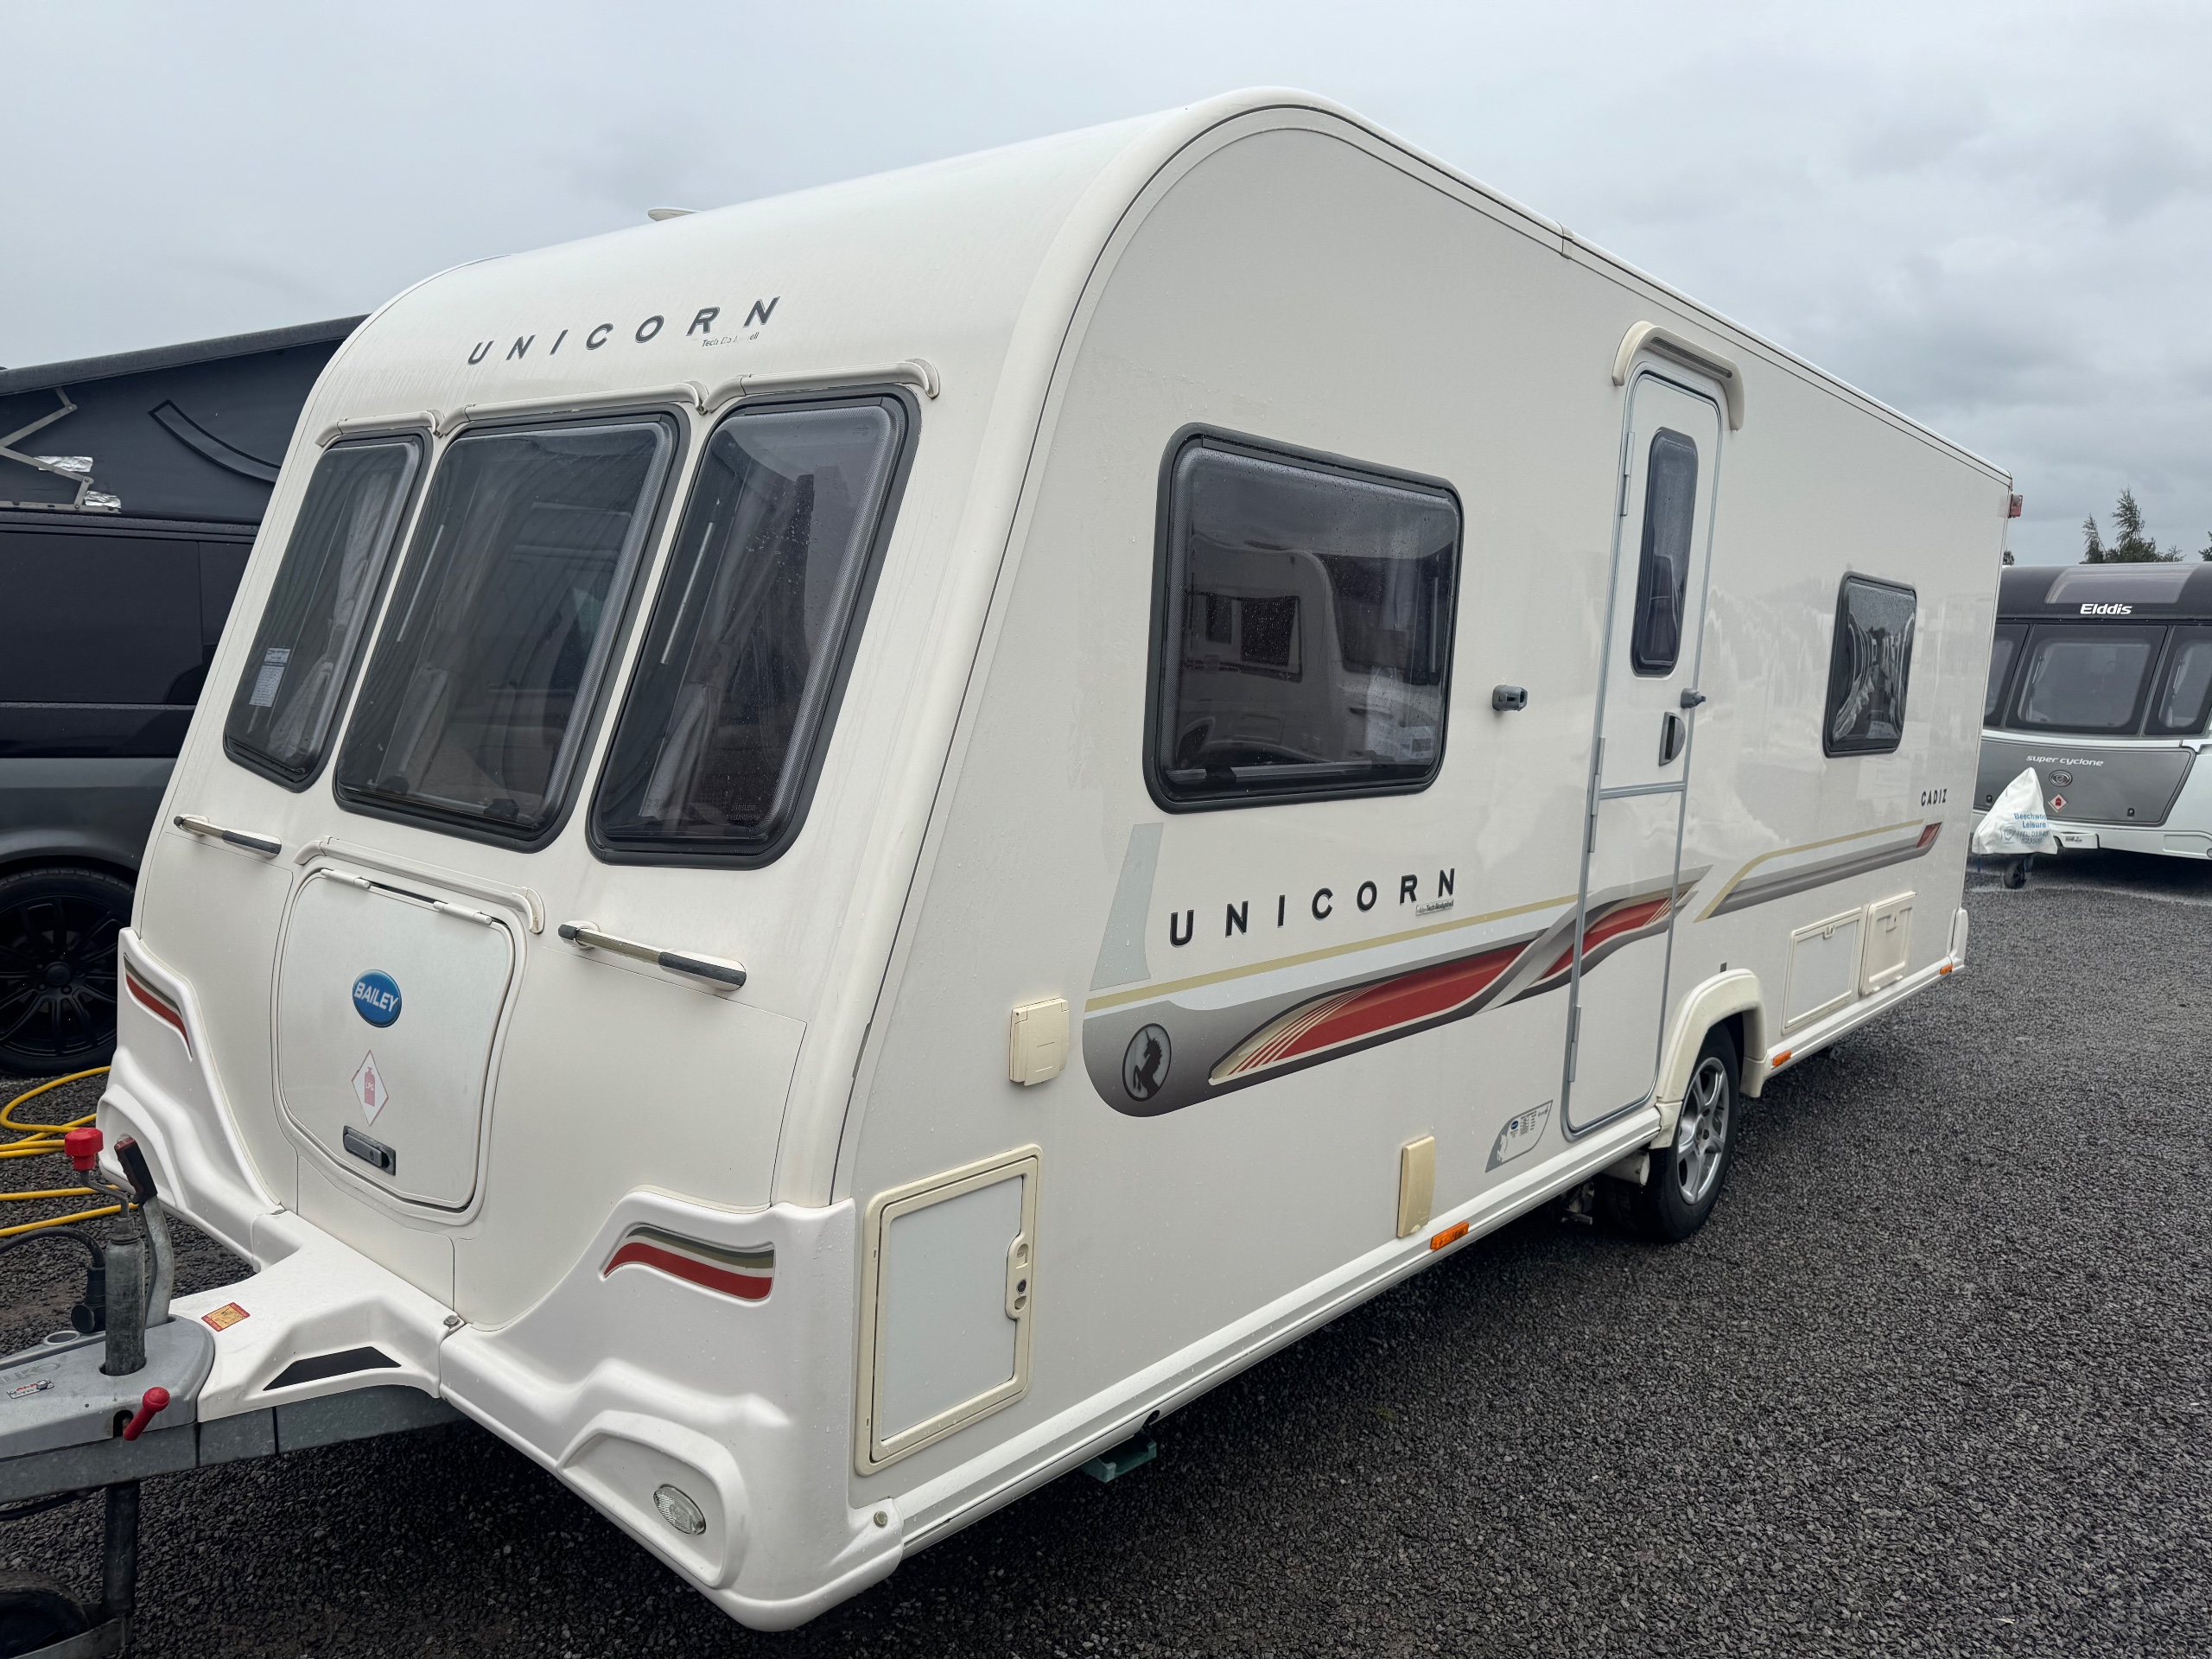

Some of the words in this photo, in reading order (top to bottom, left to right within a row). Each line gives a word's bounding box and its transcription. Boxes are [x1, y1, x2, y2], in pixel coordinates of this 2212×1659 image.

[467, 296, 781, 366] UNICORN
[2080, 603, 2133, 614] Elddis
[1921, 788, 1948, 806] CADIZ
[1169, 868, 1455, 948] UNICORN
[353, 982, 399, 1012] BAILEY
[365, 1082, 374, 1091] LPG
